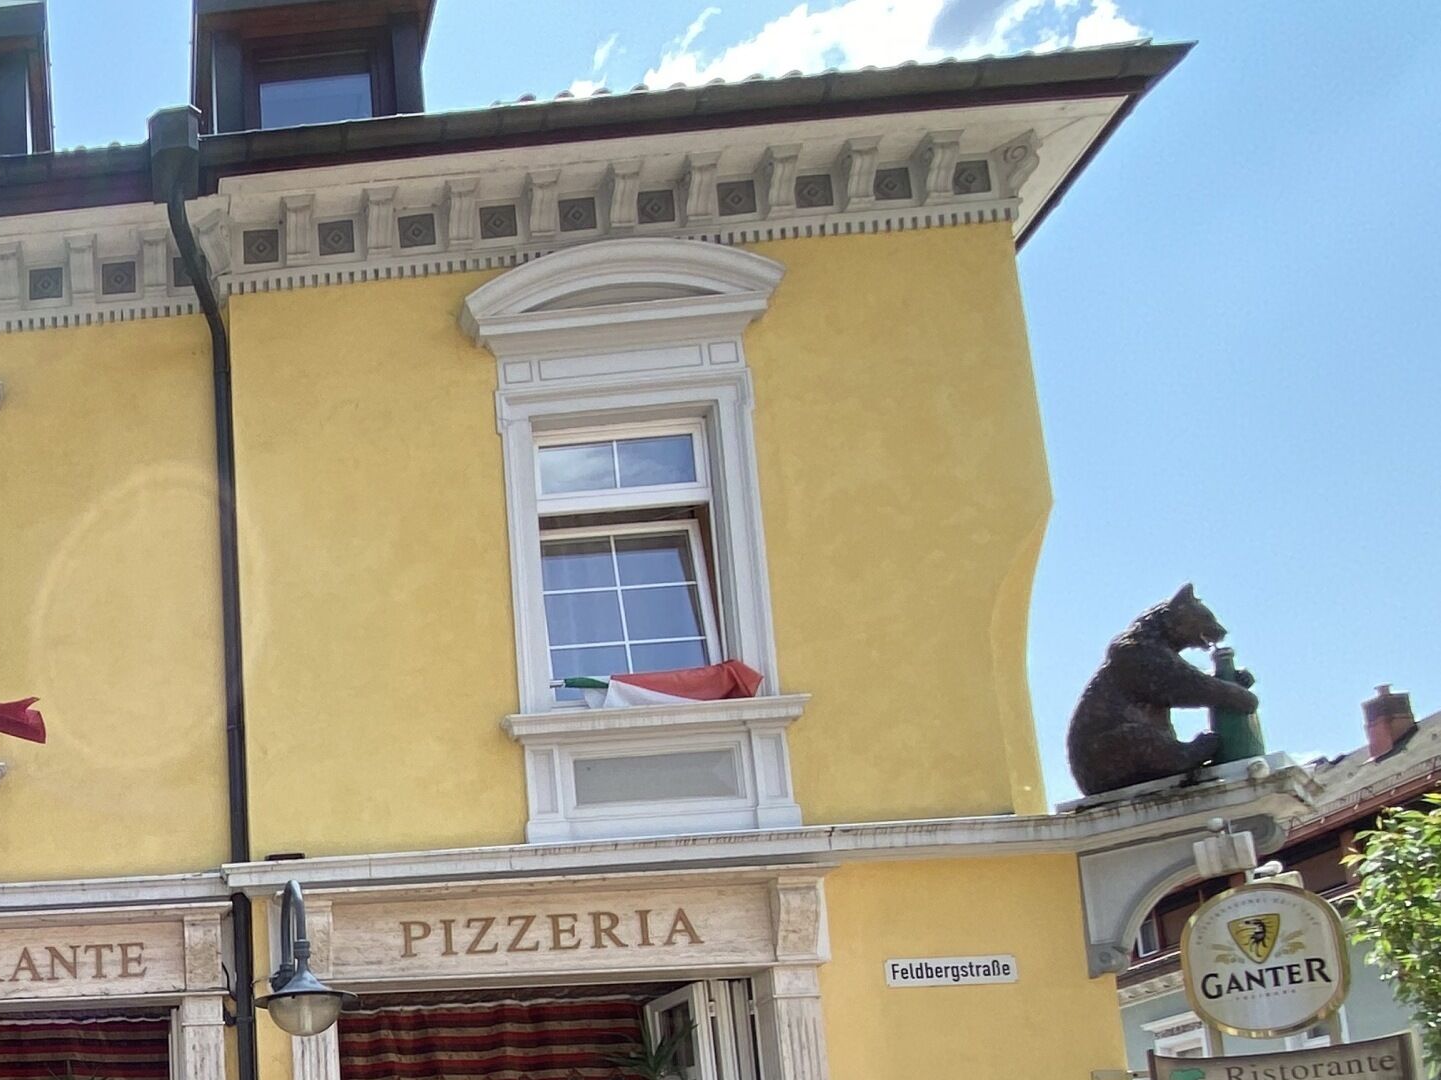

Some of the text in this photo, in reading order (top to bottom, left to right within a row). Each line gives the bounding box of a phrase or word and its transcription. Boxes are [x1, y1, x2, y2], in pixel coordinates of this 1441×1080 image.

[400, 908, 705, 958] PIZZERIA
[891, 960, 1011, 982] Feldbergstraße
[1201, 957, 1332, 999] GANTER
